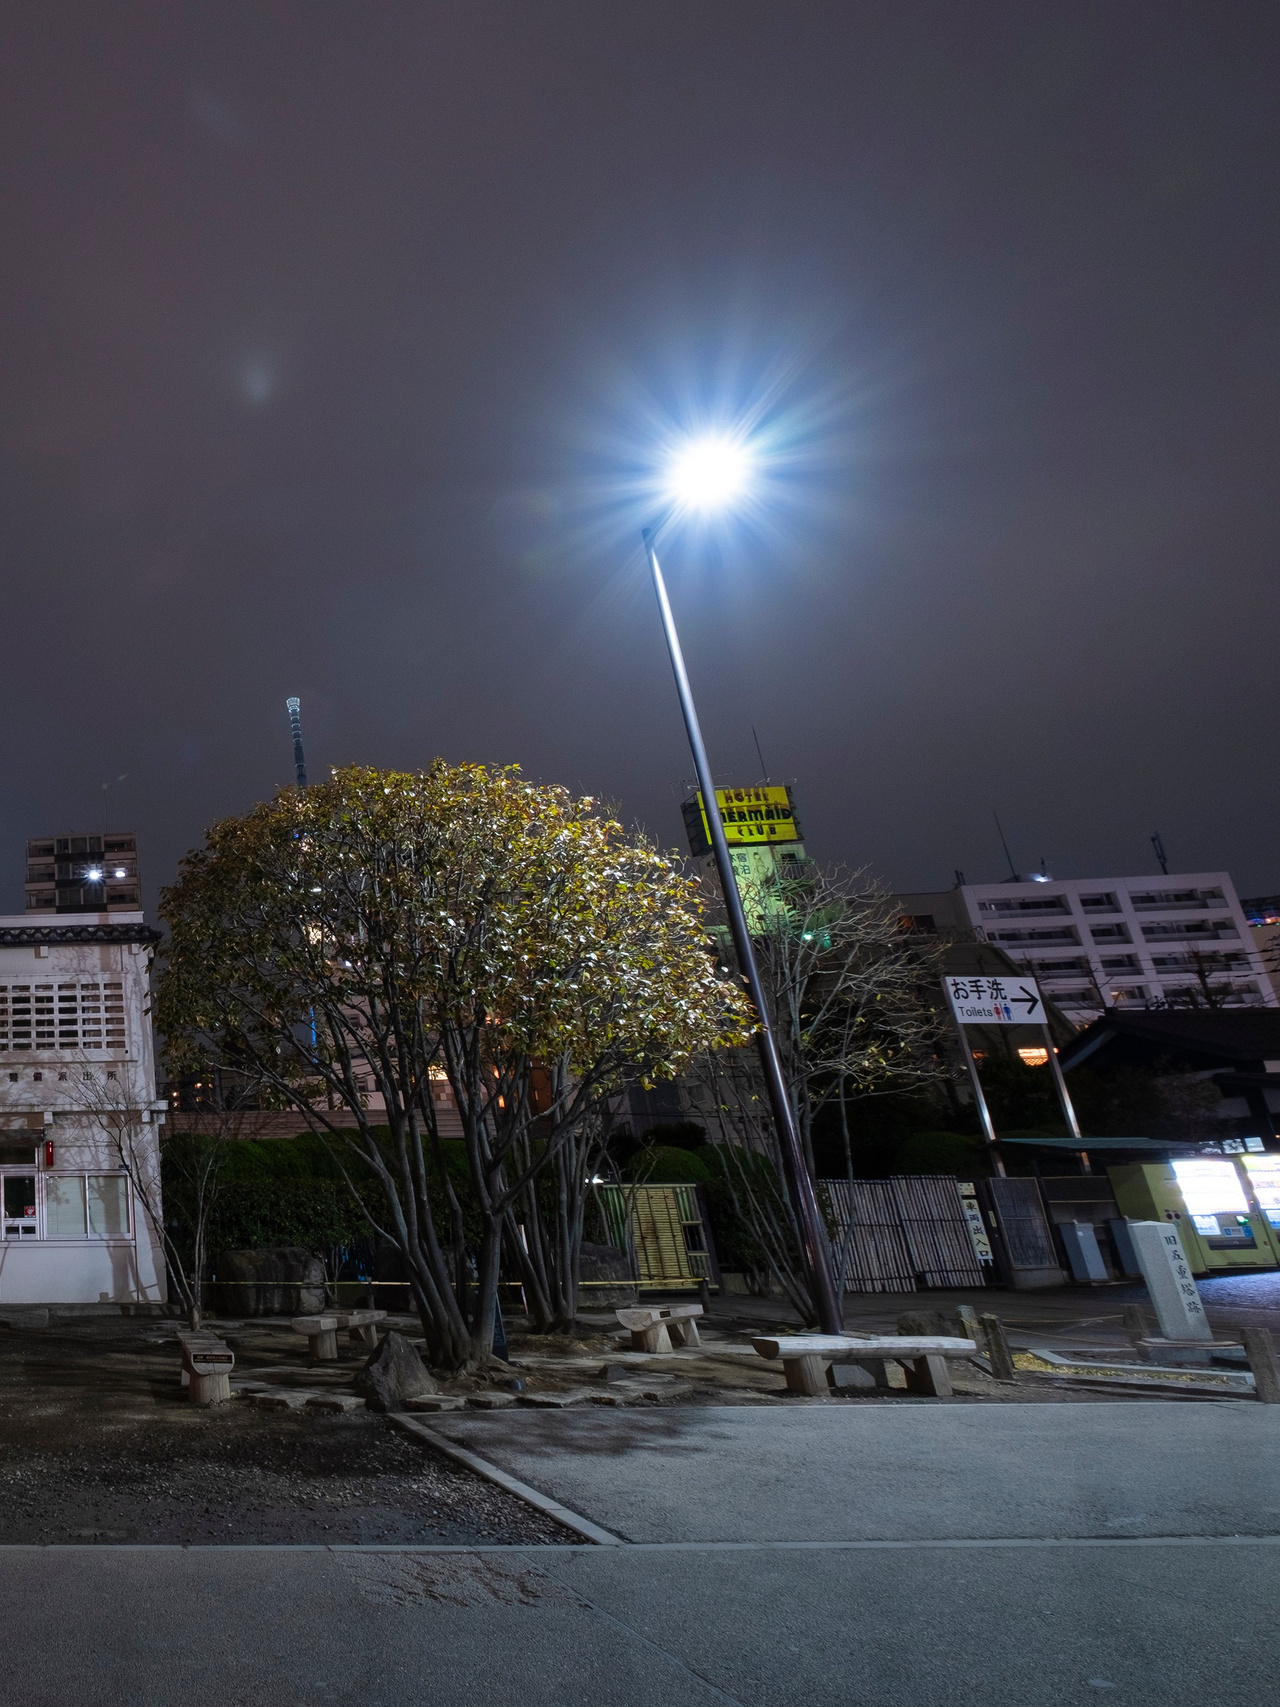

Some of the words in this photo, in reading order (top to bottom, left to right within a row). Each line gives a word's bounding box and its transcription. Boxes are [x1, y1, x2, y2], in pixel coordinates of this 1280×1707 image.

[724, 791, 769, 804] HOTEL
[737, 824, 777, 836] CLUB
[950, 978, 1008, 1001] お手洗
[957, 1006, 994, 1018] Toilets
[965, 1201, 989, 1257] 車両出入口
[1163, 1235, 1202, 1314] 旧五重塔跡
